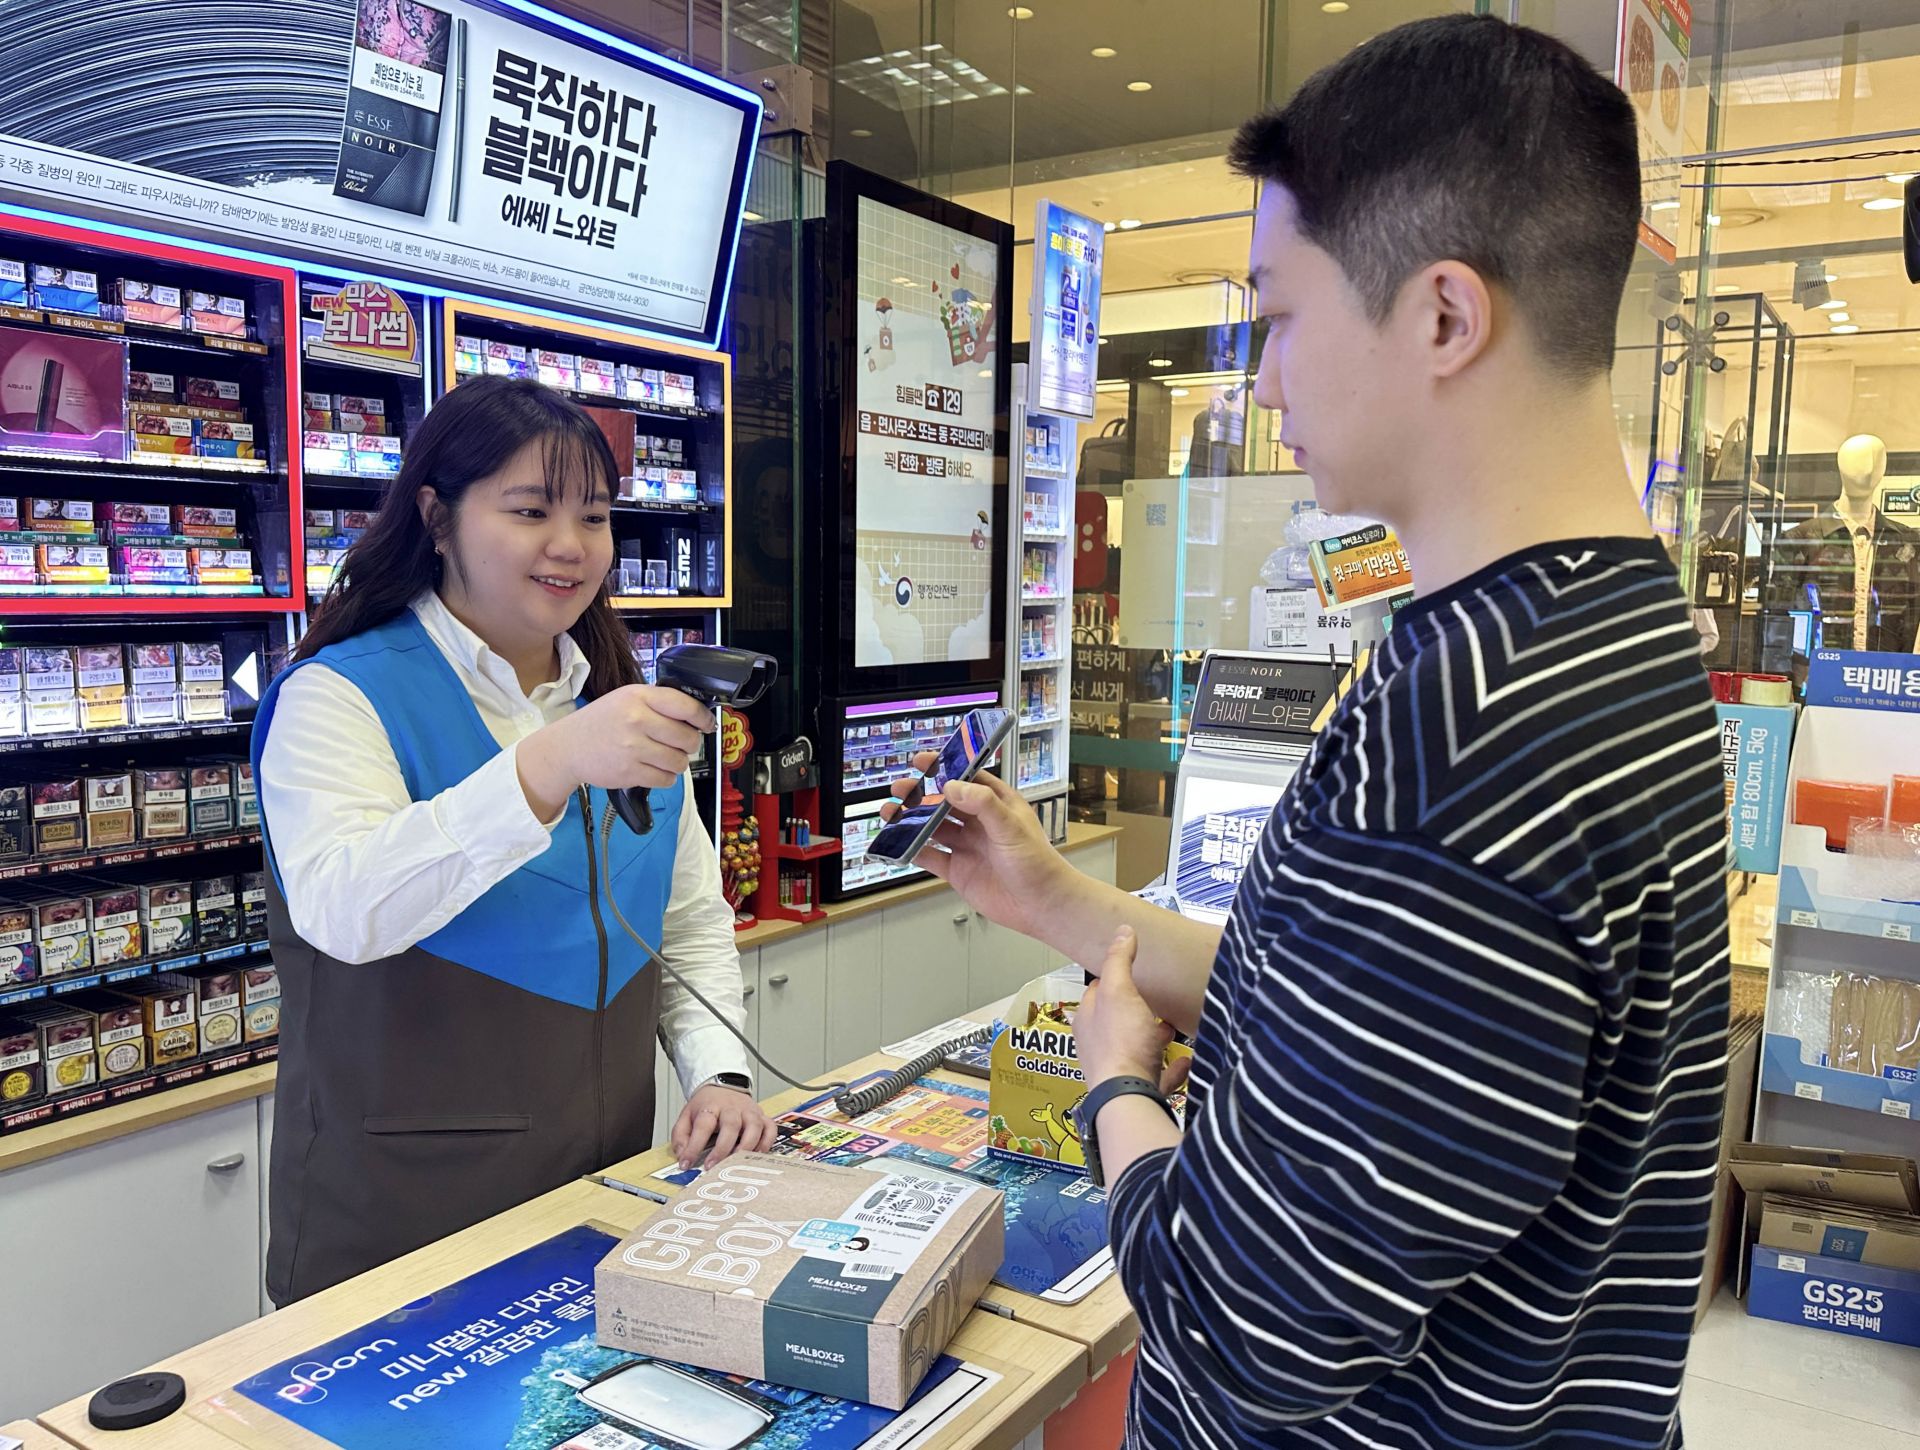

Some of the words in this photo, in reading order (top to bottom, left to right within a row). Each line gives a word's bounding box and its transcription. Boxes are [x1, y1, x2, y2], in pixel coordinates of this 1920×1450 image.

[374, 62, 401, 83] 폐암으로
[402, 71, 415, 87] 가는
[416, 75, 424, 91] 길
[400, 86, 425, 100] 1544-9030
[493, 49, 657, 159] 묵직하다
[367, 113, 393, 132] ESSE
[351, 133, 396, 153] NOIR
[483, 116, 648, 218] 블랙이다
[9, 157, 34, 174] 각종
[37, 163, 72, 182] 질병의
[76, 171, 102, 188] 원인!
[103, 178, 138, 195] 그래도
[141, 186, 220, 216] 피우시겠습니까?
[221, 204, 279, 227] 담배연기에는
[281, 217, 309, 233] 발암성
[310, 223, 338, 239] 물질인
[424, 248, 441, 262] 비닐
[578, 281, 615, 301] 금연상담전화
[615, 290, 650, 307] 1544-9030
[502, 194, 550, 234] 에쎄
[552, 208, 617, 249] 느와르
[1083, 245, 1098, 265] 차이
[313, 297, 344, 309] NEW
[346, 283, 388, 308] 믹스
[56, 317, 71, 327] 리얼
[73, 320, 96, 330] 아이스
[323, 311, 408, 347] 보나썸
[942, 388, 961, 413] 129
[139, 438, 162, 446] REAL
[919, 421, 937, 441] 또는
[938, 425, 948, 443] 동
[884, 451, 896, 470] 꼭
[1324, 541, 1340, 551] New
[1341, 535, 1364, 547] 아이코스
[1362, 529, 1380, 543] 일루마
[678, 538, 691, 588] NEW
[1333, 564, 1345, 583] 첫
[1345, 560, 1364, 579] 구매
[1363, 550, 1399, 578] 1만원
[917, 584, 958, 600] 행정안전부
[1076, 650, 1131, 672] 편하게.
[1817, 652, 1841, 661] GS25
[1226, 665, 1247, 676] ESSE
[1250, 666, 1283, 678] NOIR
[1090, 681, 1129, 703] 싸게.
[1213, 684, 1263, 700] 묵직하다
[1264, 686, 1316, 704] 블랙이다
[1208, 700, 1247, 723] 에쎄
[1249, 704, 1311, 728] 느와르
[1746, 728, 1768, 755] 5kg
[781, 749, 805, 768] Cricket
[1741, 804, 1759, 820] 합
[1741, 823, 1757, 850] 세변
[1210, 867, 1235, 884] 에쎄
[200, 917, 223, 926] Raison
[244, 909, 267, 917] Raison
[98, 934, 126, 945] Raison
[152, 925, 178, 935] Raison
[45, 944, 73, 955] Raison
[265, 1013, 274, 1022] fit
[163, 1036, 188, 1047] CARIBE
[1016, 1056, 1086, 1080] Goldbäre
[686, 1211, 806, 1286] BOX
[807, 1276, 868, 1292] MEALBOX25
[1803, 1280, 1884, 1314] GS25
[379, 1316, 501, 1380] 미니멀한
[497, 1276, 590, 1320] 디자인
[1802, 1304, 1881, 1333] 편의점택배
[388, 1363, 469, 1411] new
[463, 1316, 561, 1368] 깔끔한
[785, 1342, 846, 1365] MEALBOX25
[275, 1338, 398, 1405] ploom
